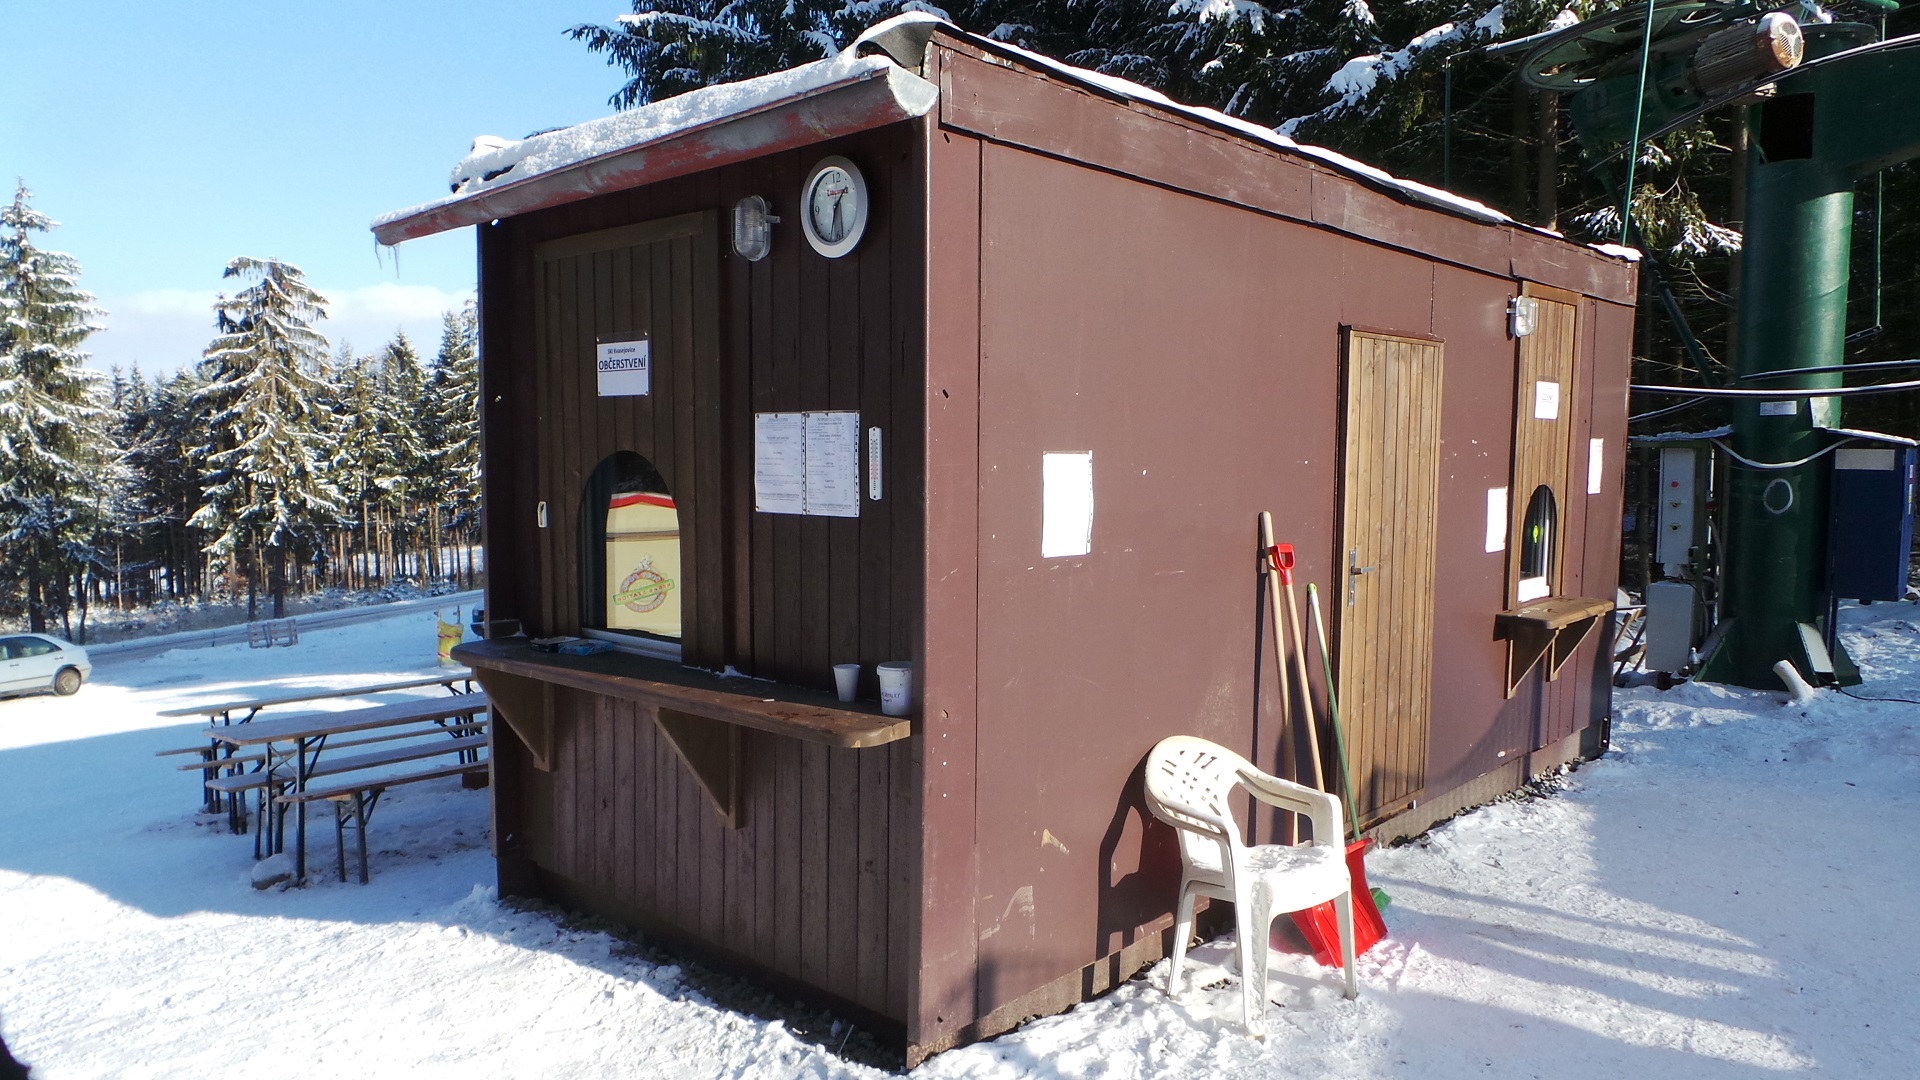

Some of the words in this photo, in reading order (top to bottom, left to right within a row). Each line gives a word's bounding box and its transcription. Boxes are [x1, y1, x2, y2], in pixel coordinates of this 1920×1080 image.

[832, 172, 841, 183] 12
[815, 205, 820, 216] 9
[599, 355, 646, 370] OBČERSTVENÍ
